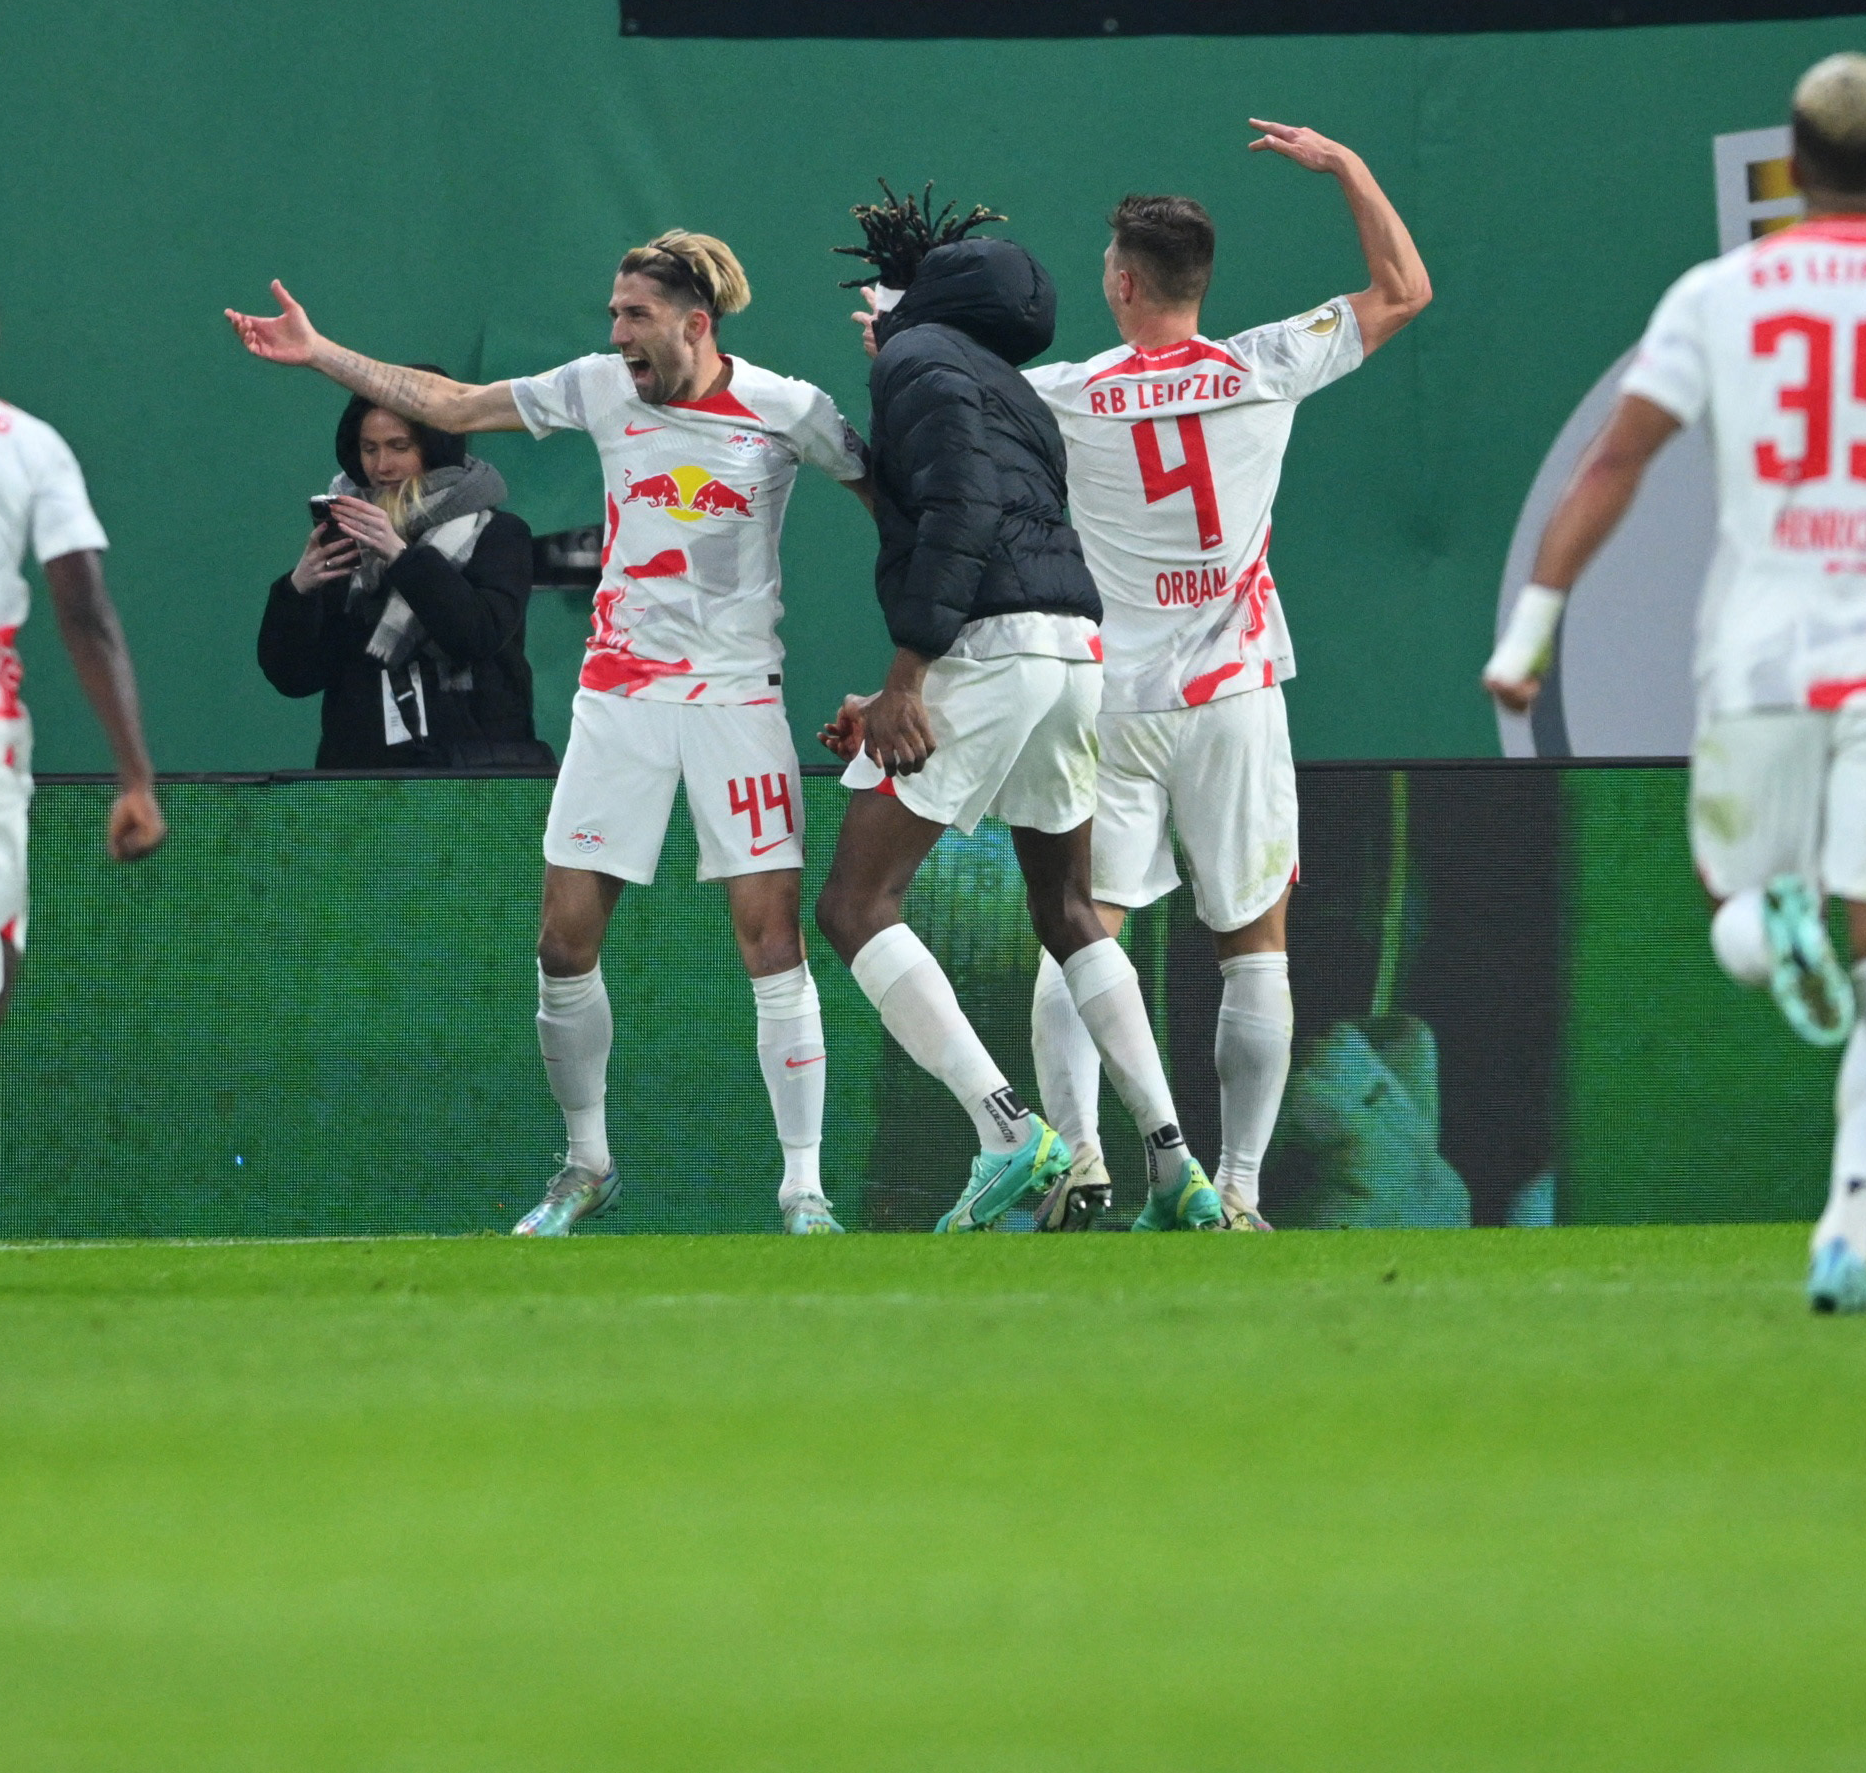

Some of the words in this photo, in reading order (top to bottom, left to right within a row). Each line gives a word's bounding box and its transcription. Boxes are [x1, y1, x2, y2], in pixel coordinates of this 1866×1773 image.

[1090, 386, 1127, 415] RB
[1137, 373, 1242, 411] LEIPZIG
[1130, 412, 1223, 552] 4
[1155, 560, 1227, 607] ORBÁN
[727, 772, 795, 840] 44
